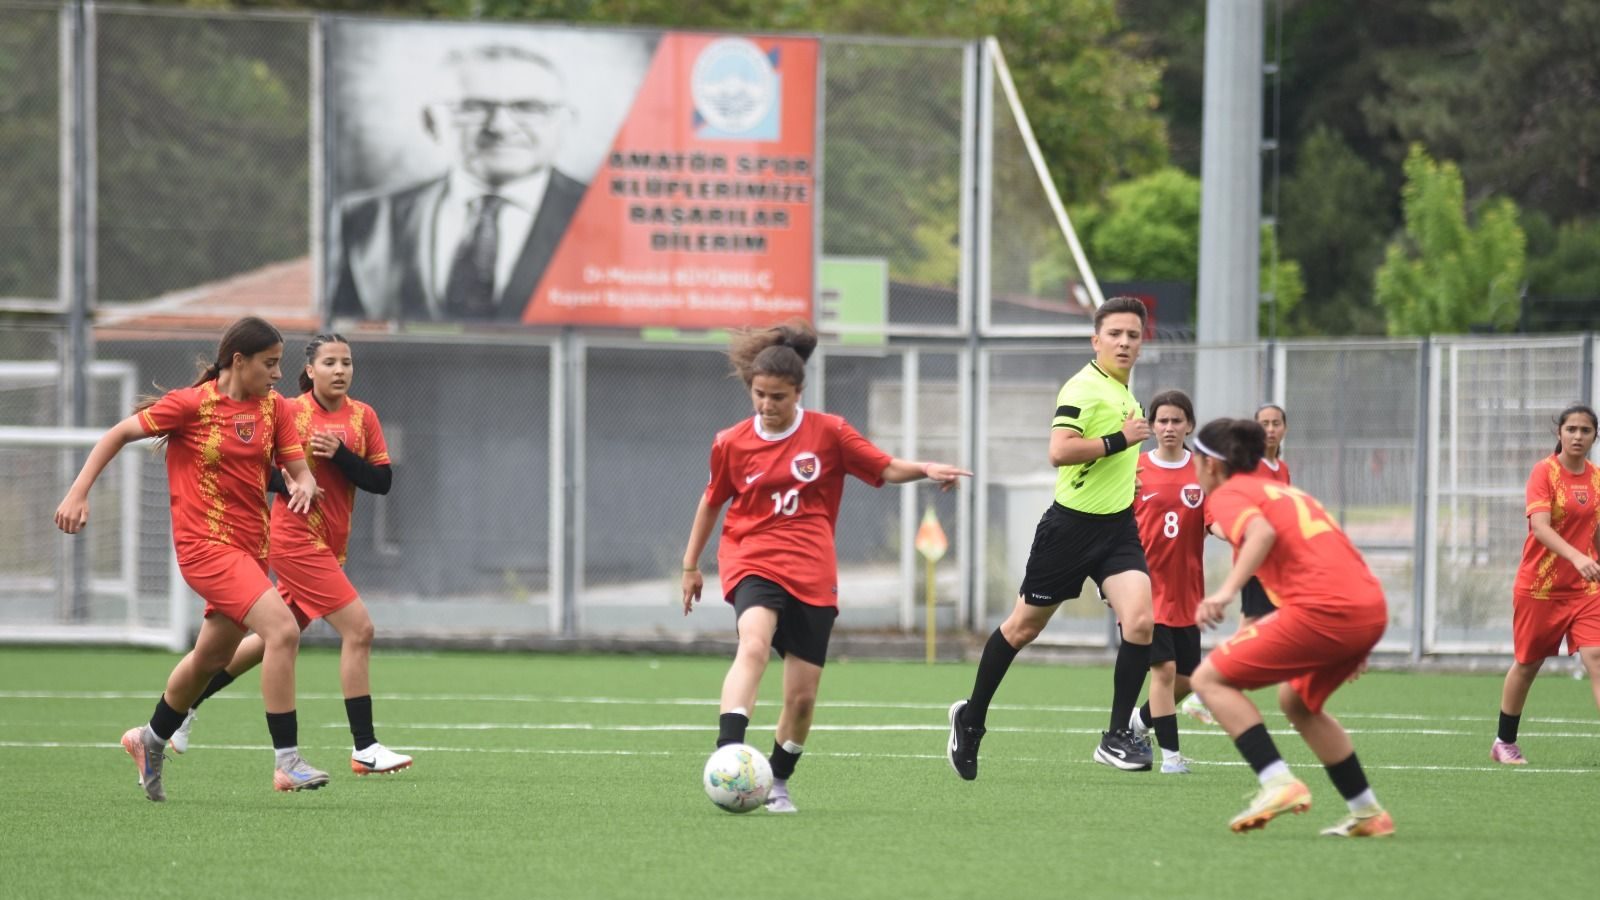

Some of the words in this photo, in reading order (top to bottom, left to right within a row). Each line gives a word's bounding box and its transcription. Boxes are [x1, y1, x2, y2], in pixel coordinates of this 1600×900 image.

[609, 151, 727, 171] AMATÖR
[736, 155, 811, 174] SPOR
[771, 489, 799, 516] 10
[1163, 511, 1179, 538] 8
